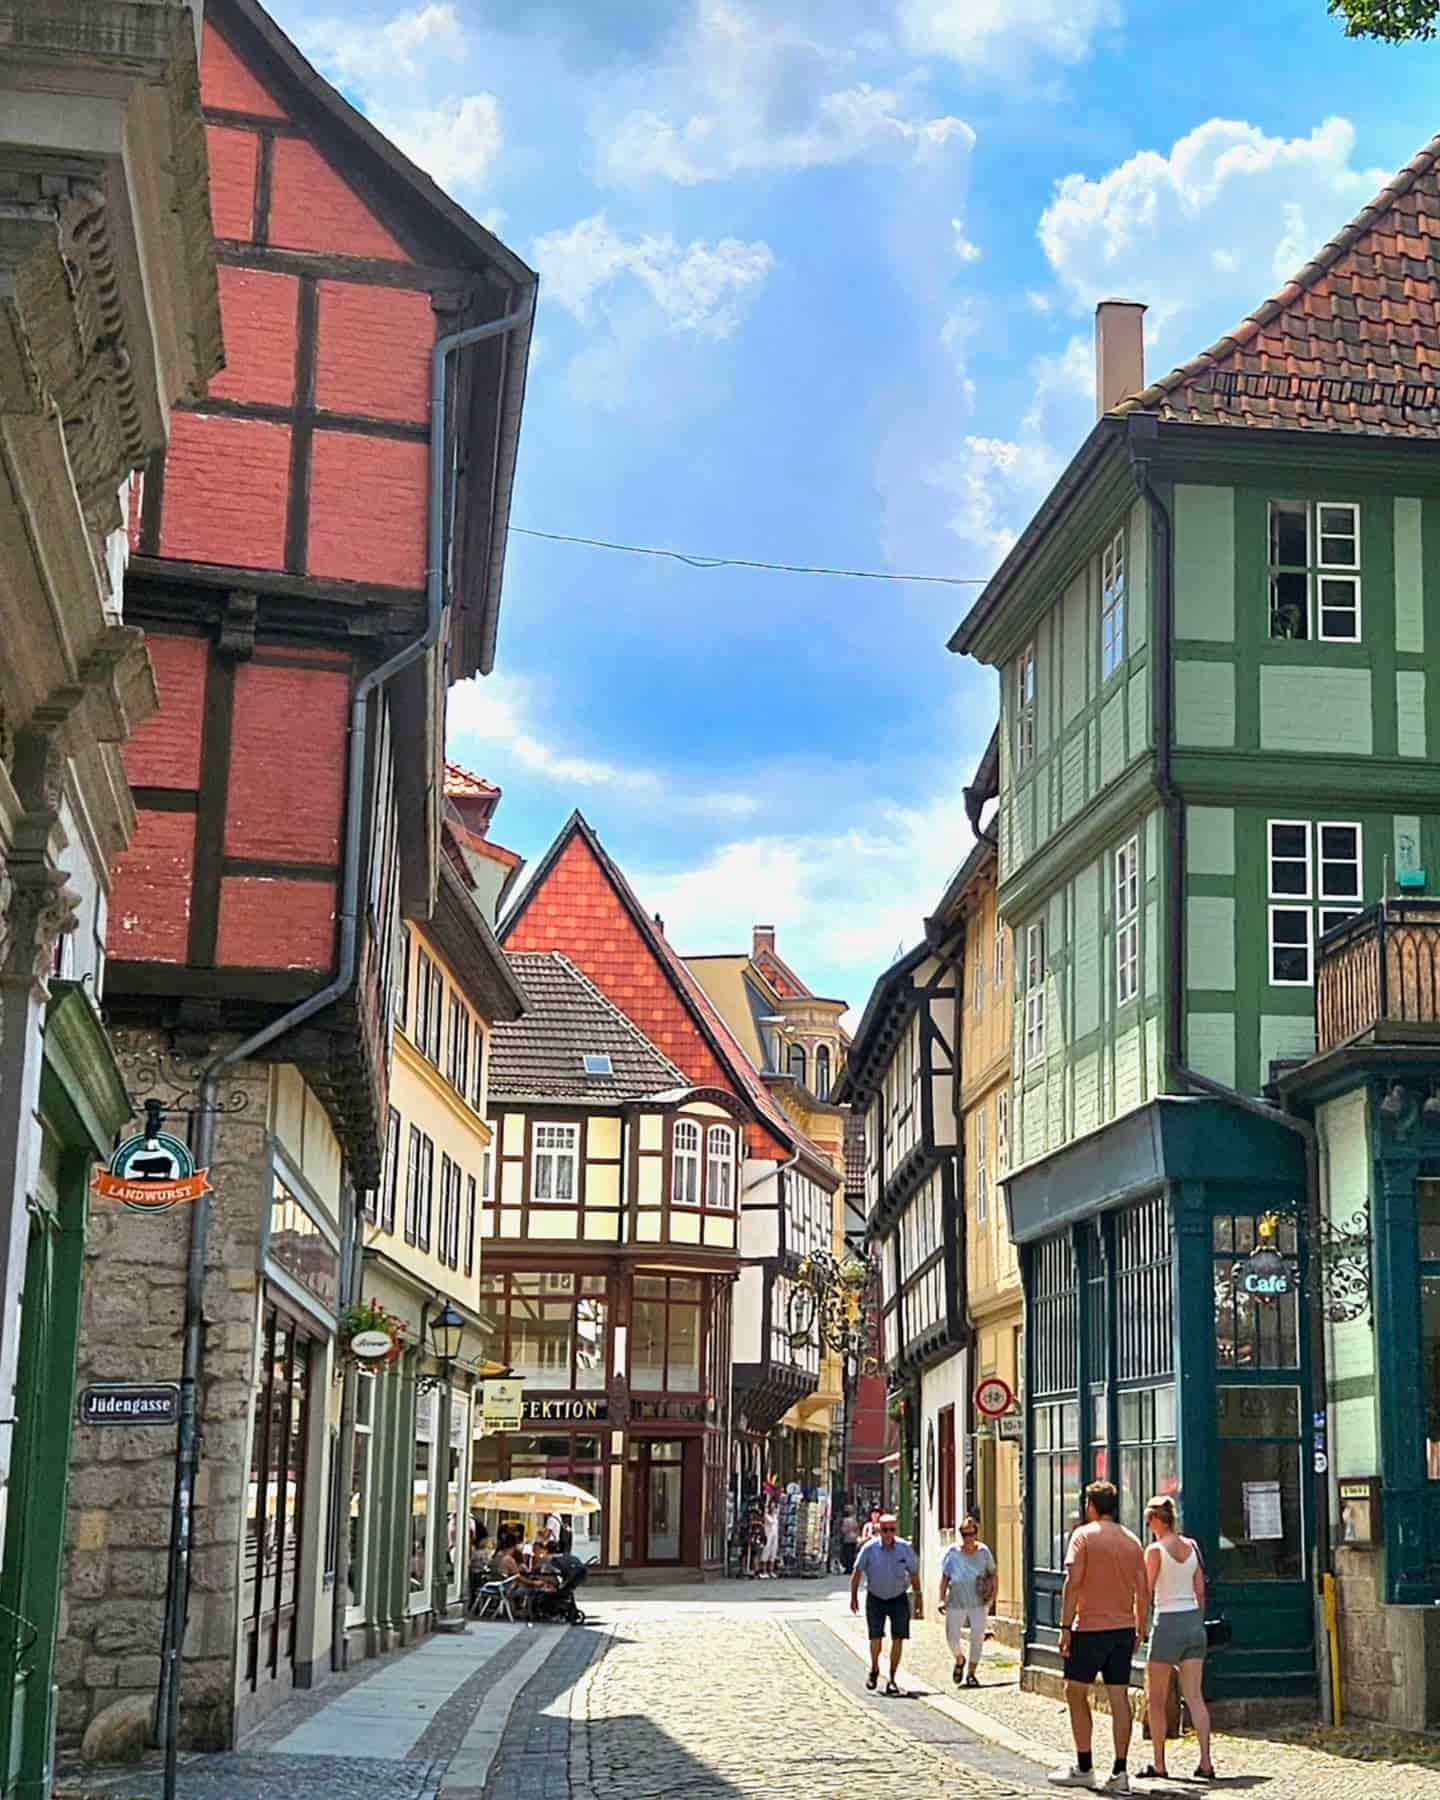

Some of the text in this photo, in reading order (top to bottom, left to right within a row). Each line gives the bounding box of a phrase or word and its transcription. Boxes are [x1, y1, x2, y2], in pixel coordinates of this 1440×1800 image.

[108, 1184, 192, 1201] LANDWURST
[1245, 1274, 1288, 1292] Café
[89, 1397, 171, 1414] Jüdengasse
